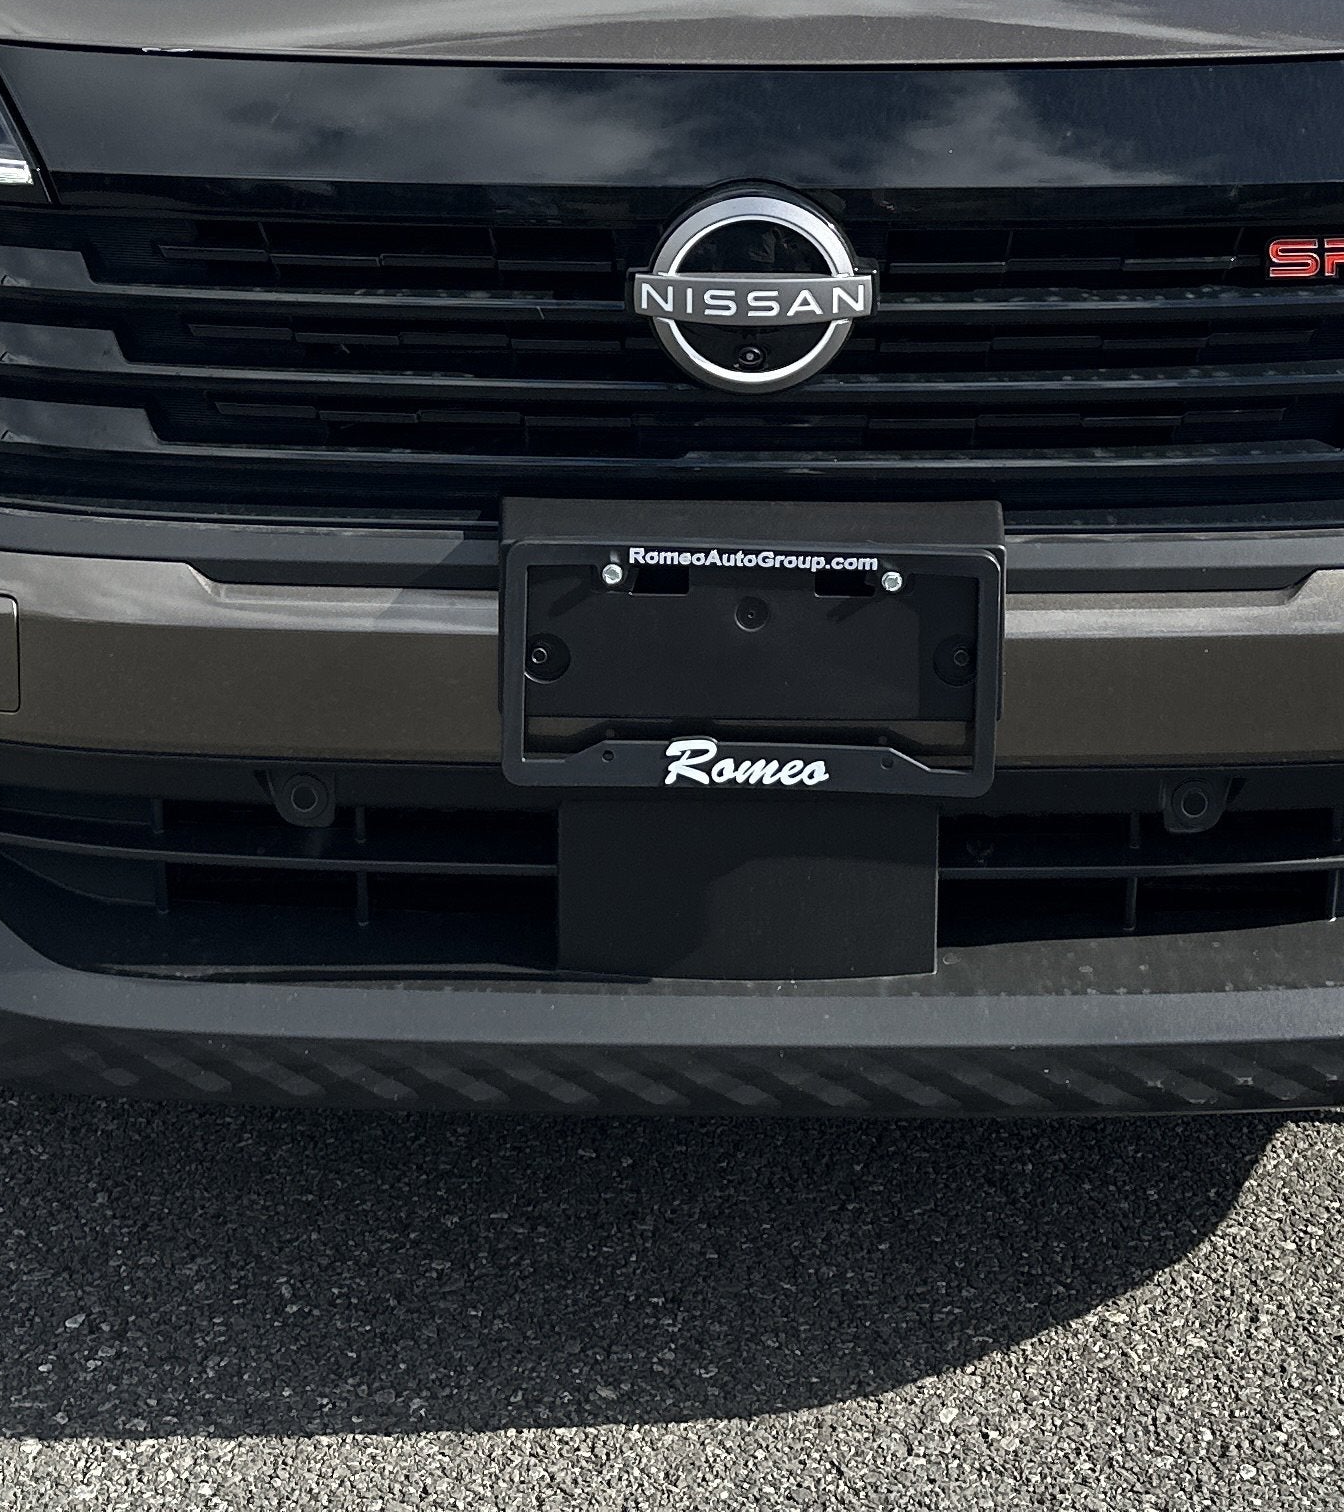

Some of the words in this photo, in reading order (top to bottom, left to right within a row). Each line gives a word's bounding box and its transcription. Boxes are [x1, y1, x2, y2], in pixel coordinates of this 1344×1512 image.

[641, 283, 865, 317] NISSAN
[629, 547, 878, 572] RomeoAutoGroup.com
[664, 739, 830, 786] Romeo
